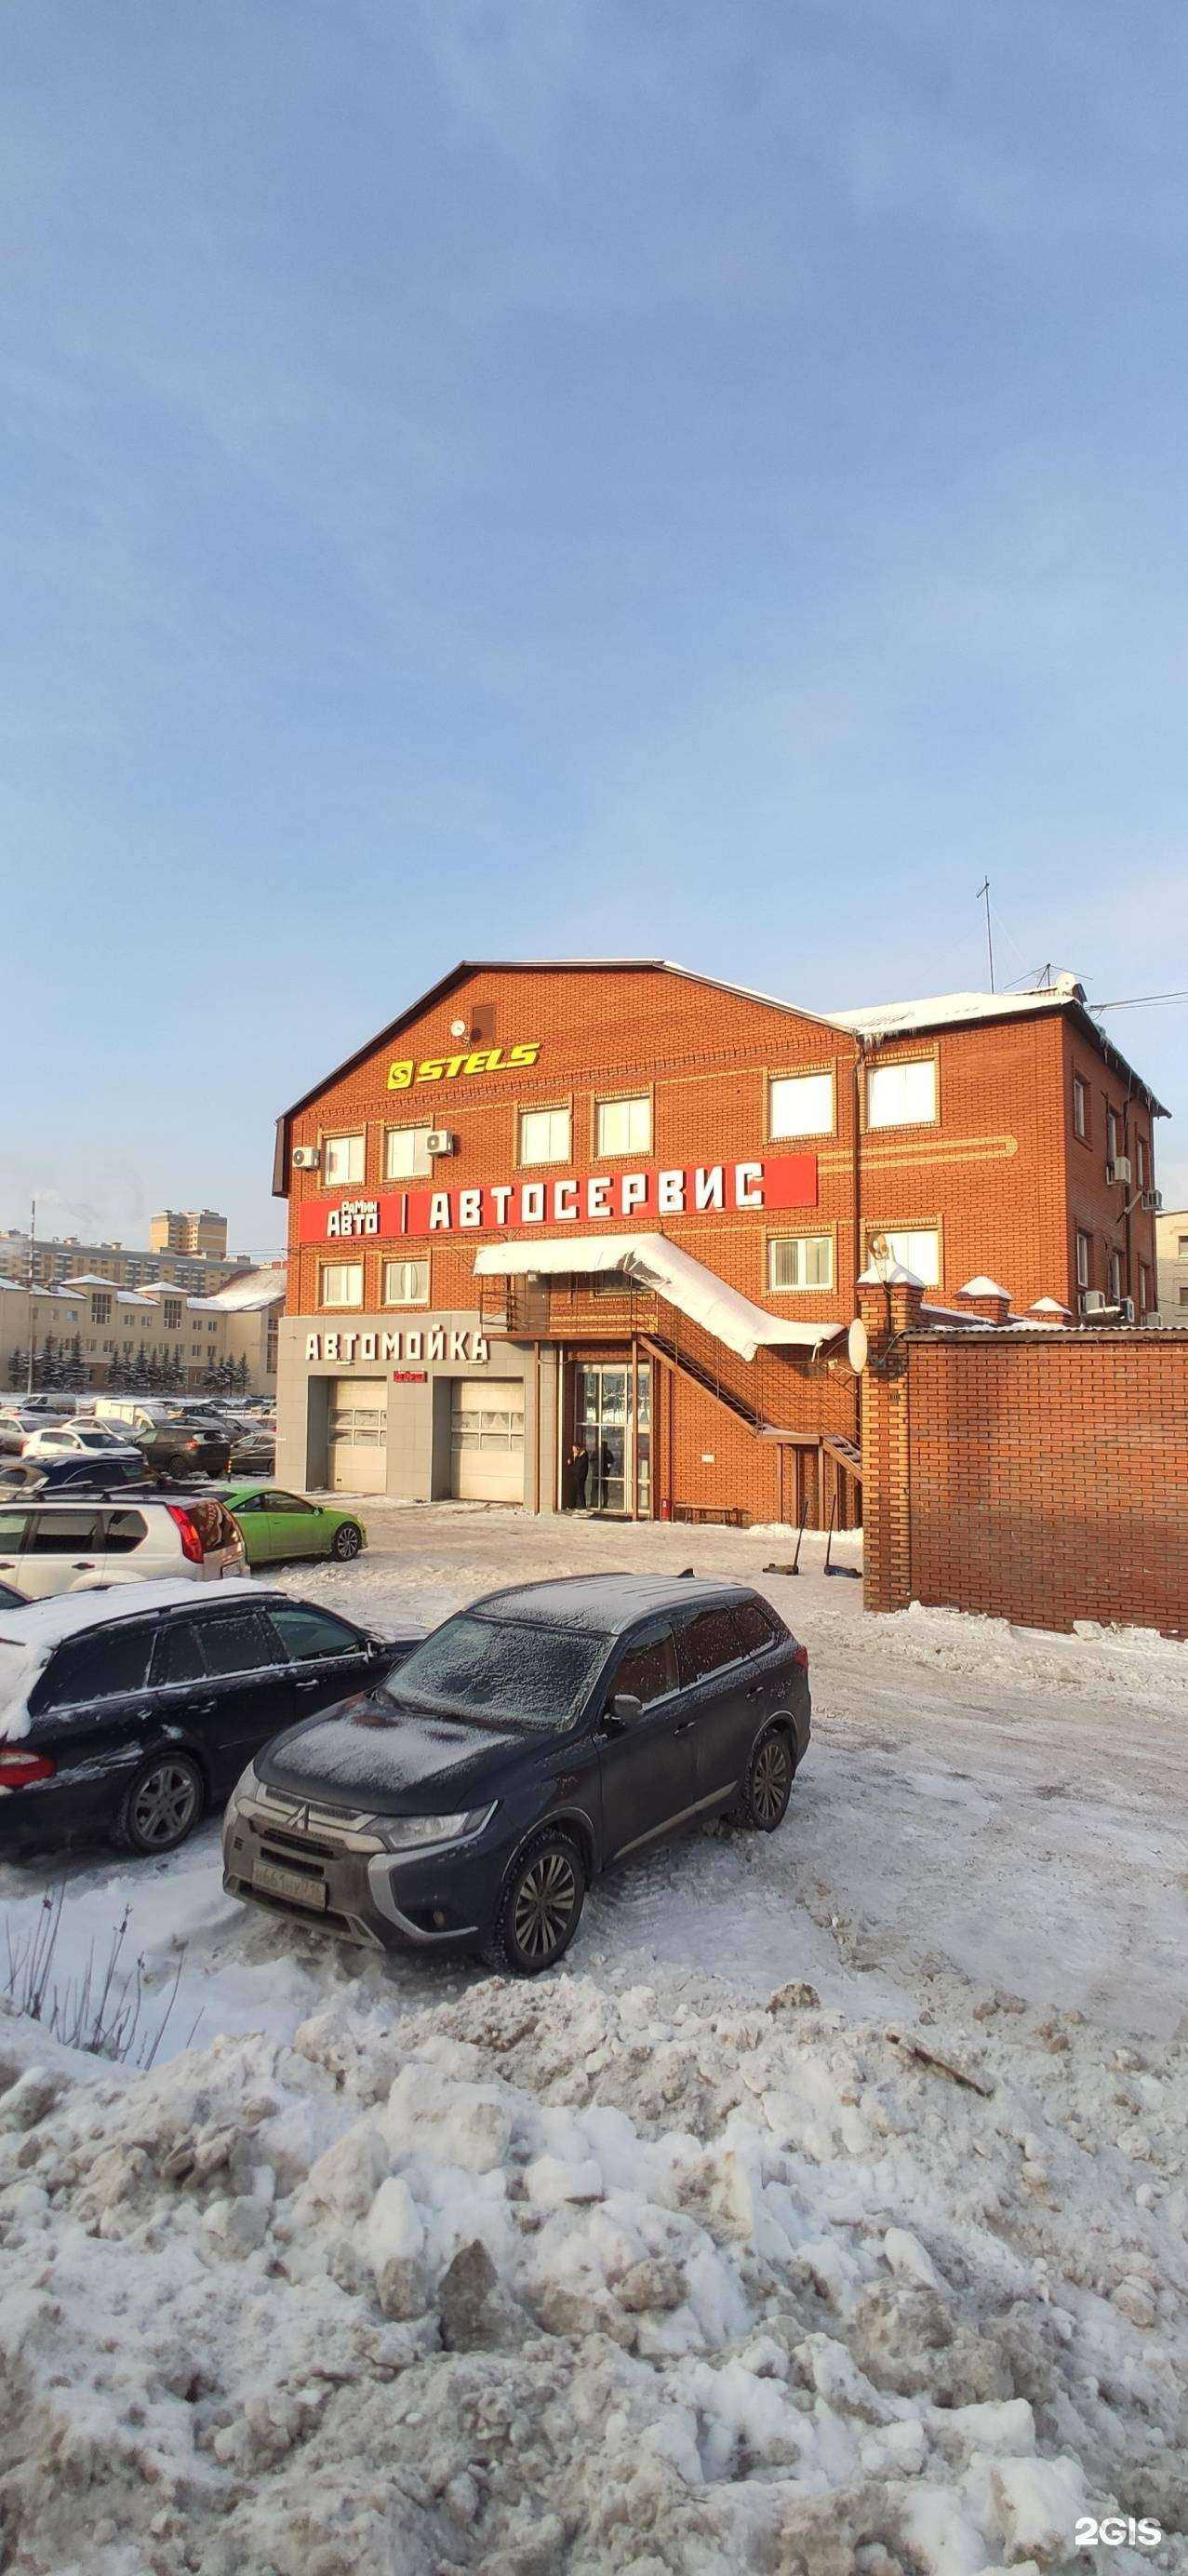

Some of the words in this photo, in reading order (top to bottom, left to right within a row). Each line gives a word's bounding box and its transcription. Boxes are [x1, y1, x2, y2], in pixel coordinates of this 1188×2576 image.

[416, 1041, 541, 1083] STELS
[428, 1162, 766, 1229] АВТОСЕРВИС
[305, 1323, 488, 1361] АВТОМОЙКА
